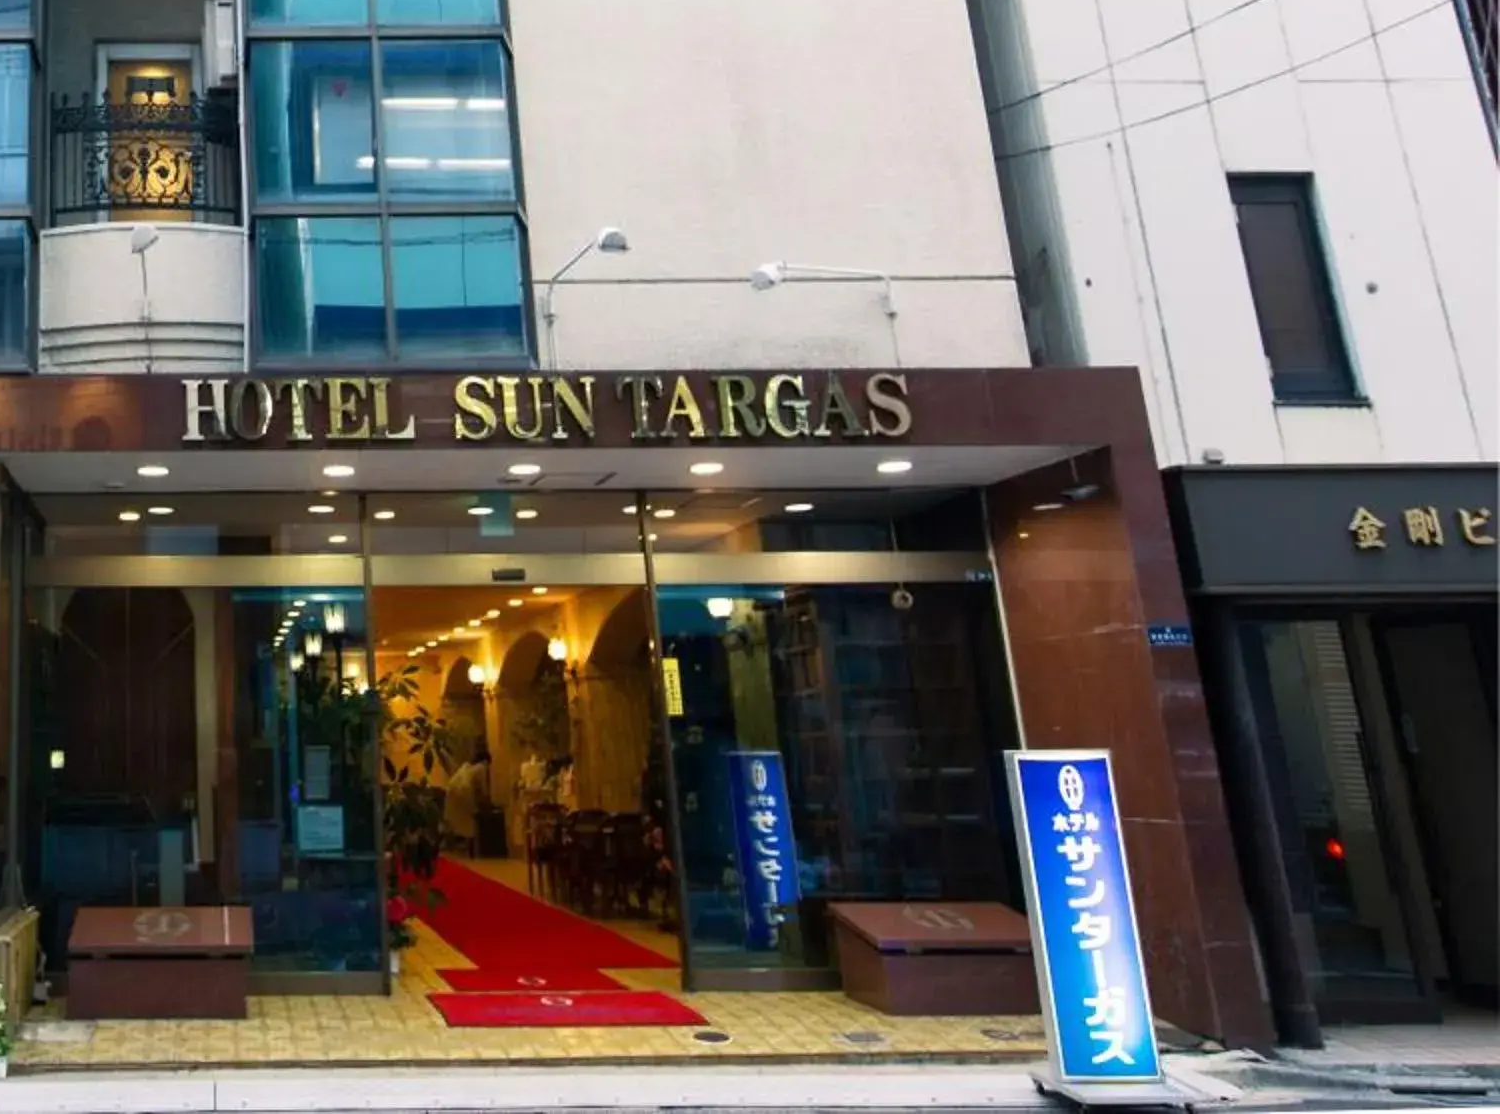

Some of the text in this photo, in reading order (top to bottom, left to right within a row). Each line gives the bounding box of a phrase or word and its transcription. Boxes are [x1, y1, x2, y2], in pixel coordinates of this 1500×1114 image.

[181, 373, 913, 443] HOTEL SUN TARGAS
[1348, 505, 1497, 549] 金剛ビ
[1052, 812, 1100, 833] ホテル
[1056, 835, 1136, 1066] サンターガス
